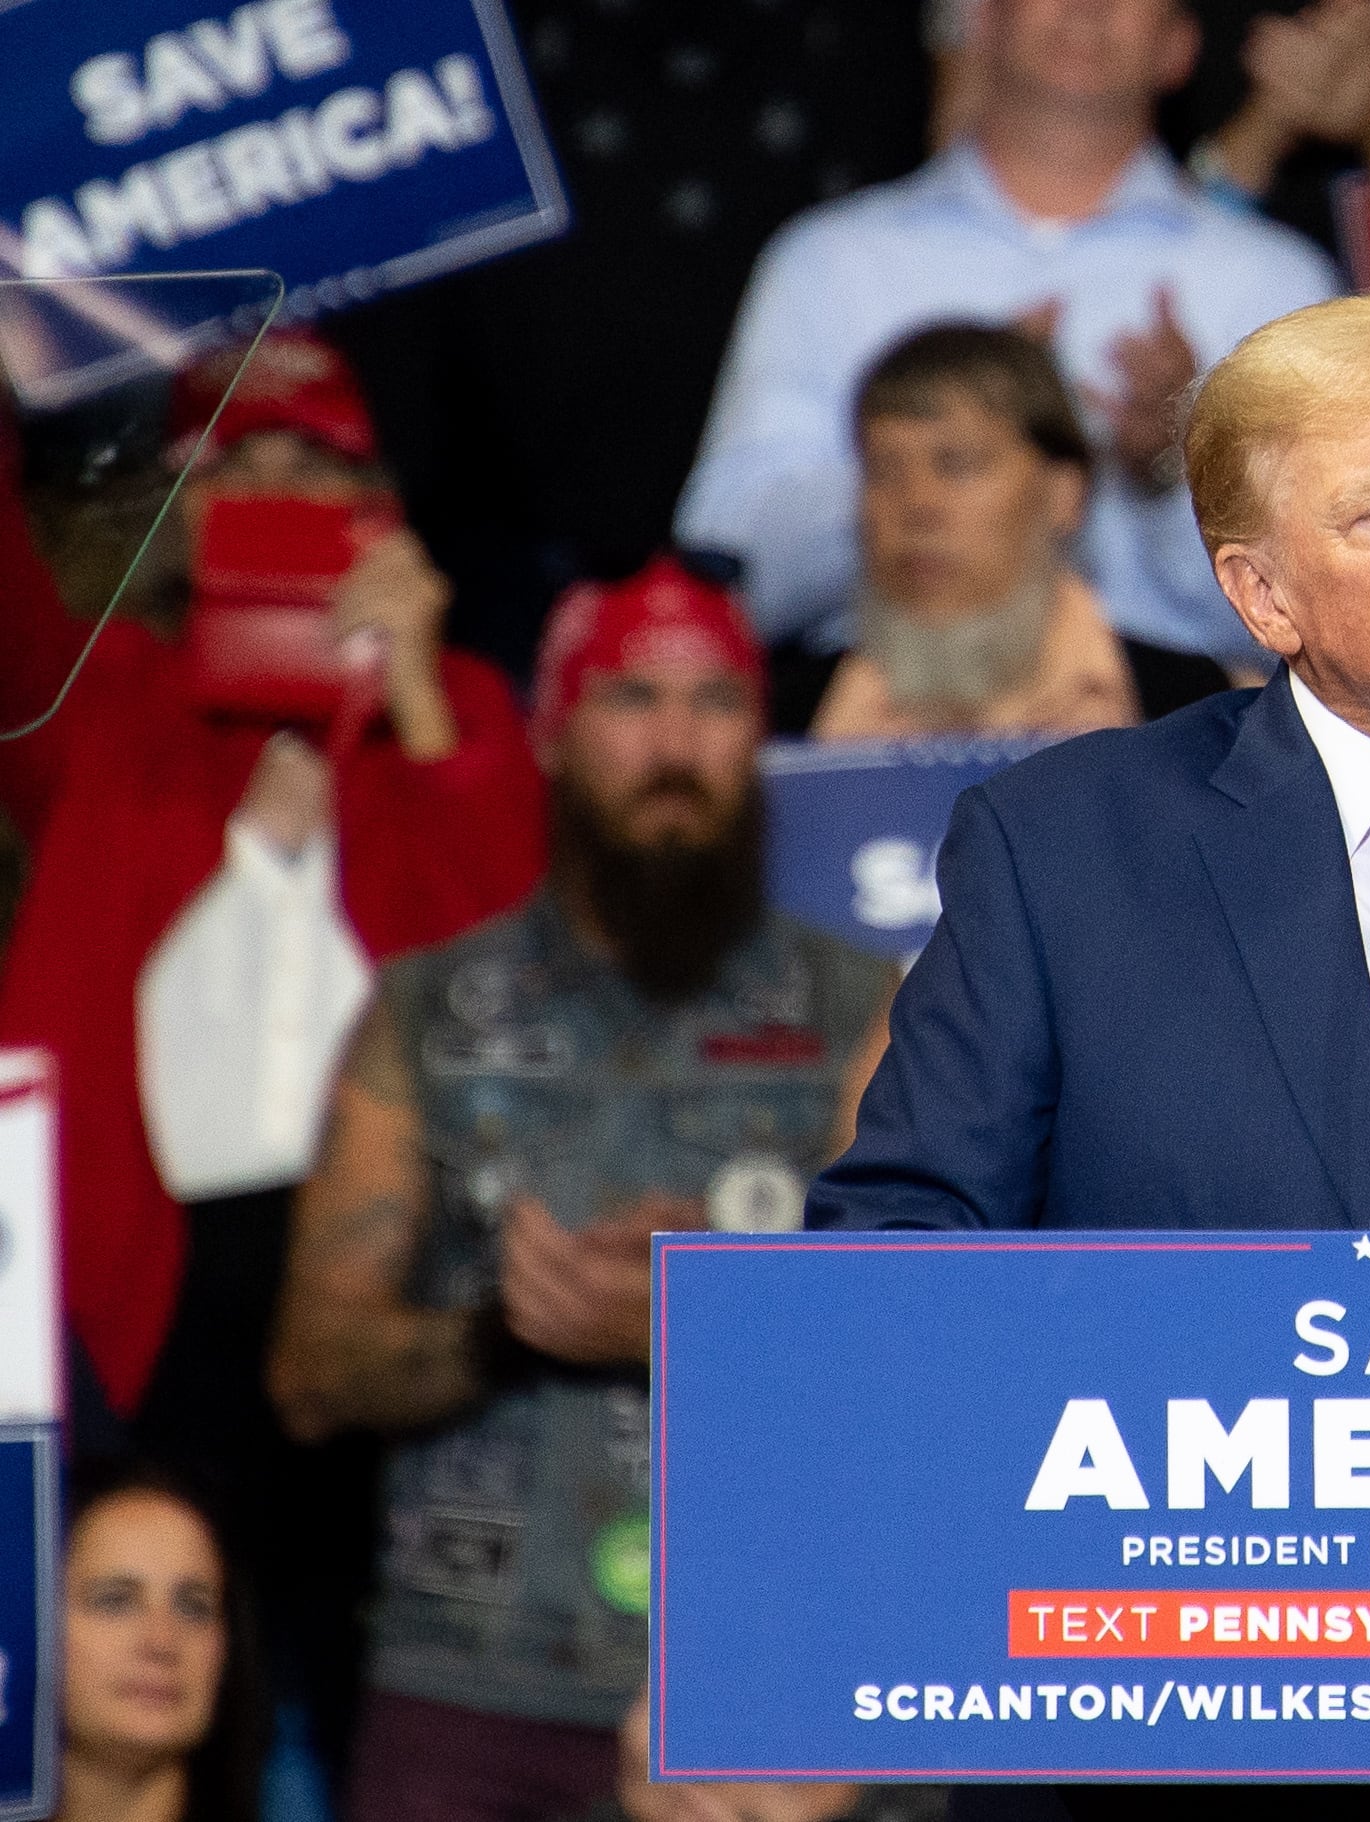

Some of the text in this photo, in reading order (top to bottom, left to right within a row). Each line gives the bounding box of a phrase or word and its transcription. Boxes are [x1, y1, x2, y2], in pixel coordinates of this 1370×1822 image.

[71, 0, 350, 145] SAVE
[19, 52, 496, 280] AMERICA!
[1122, 1535, 1356, 1566] PRESIDENT
[1028, 1605, 1158, 1642] TEXT
